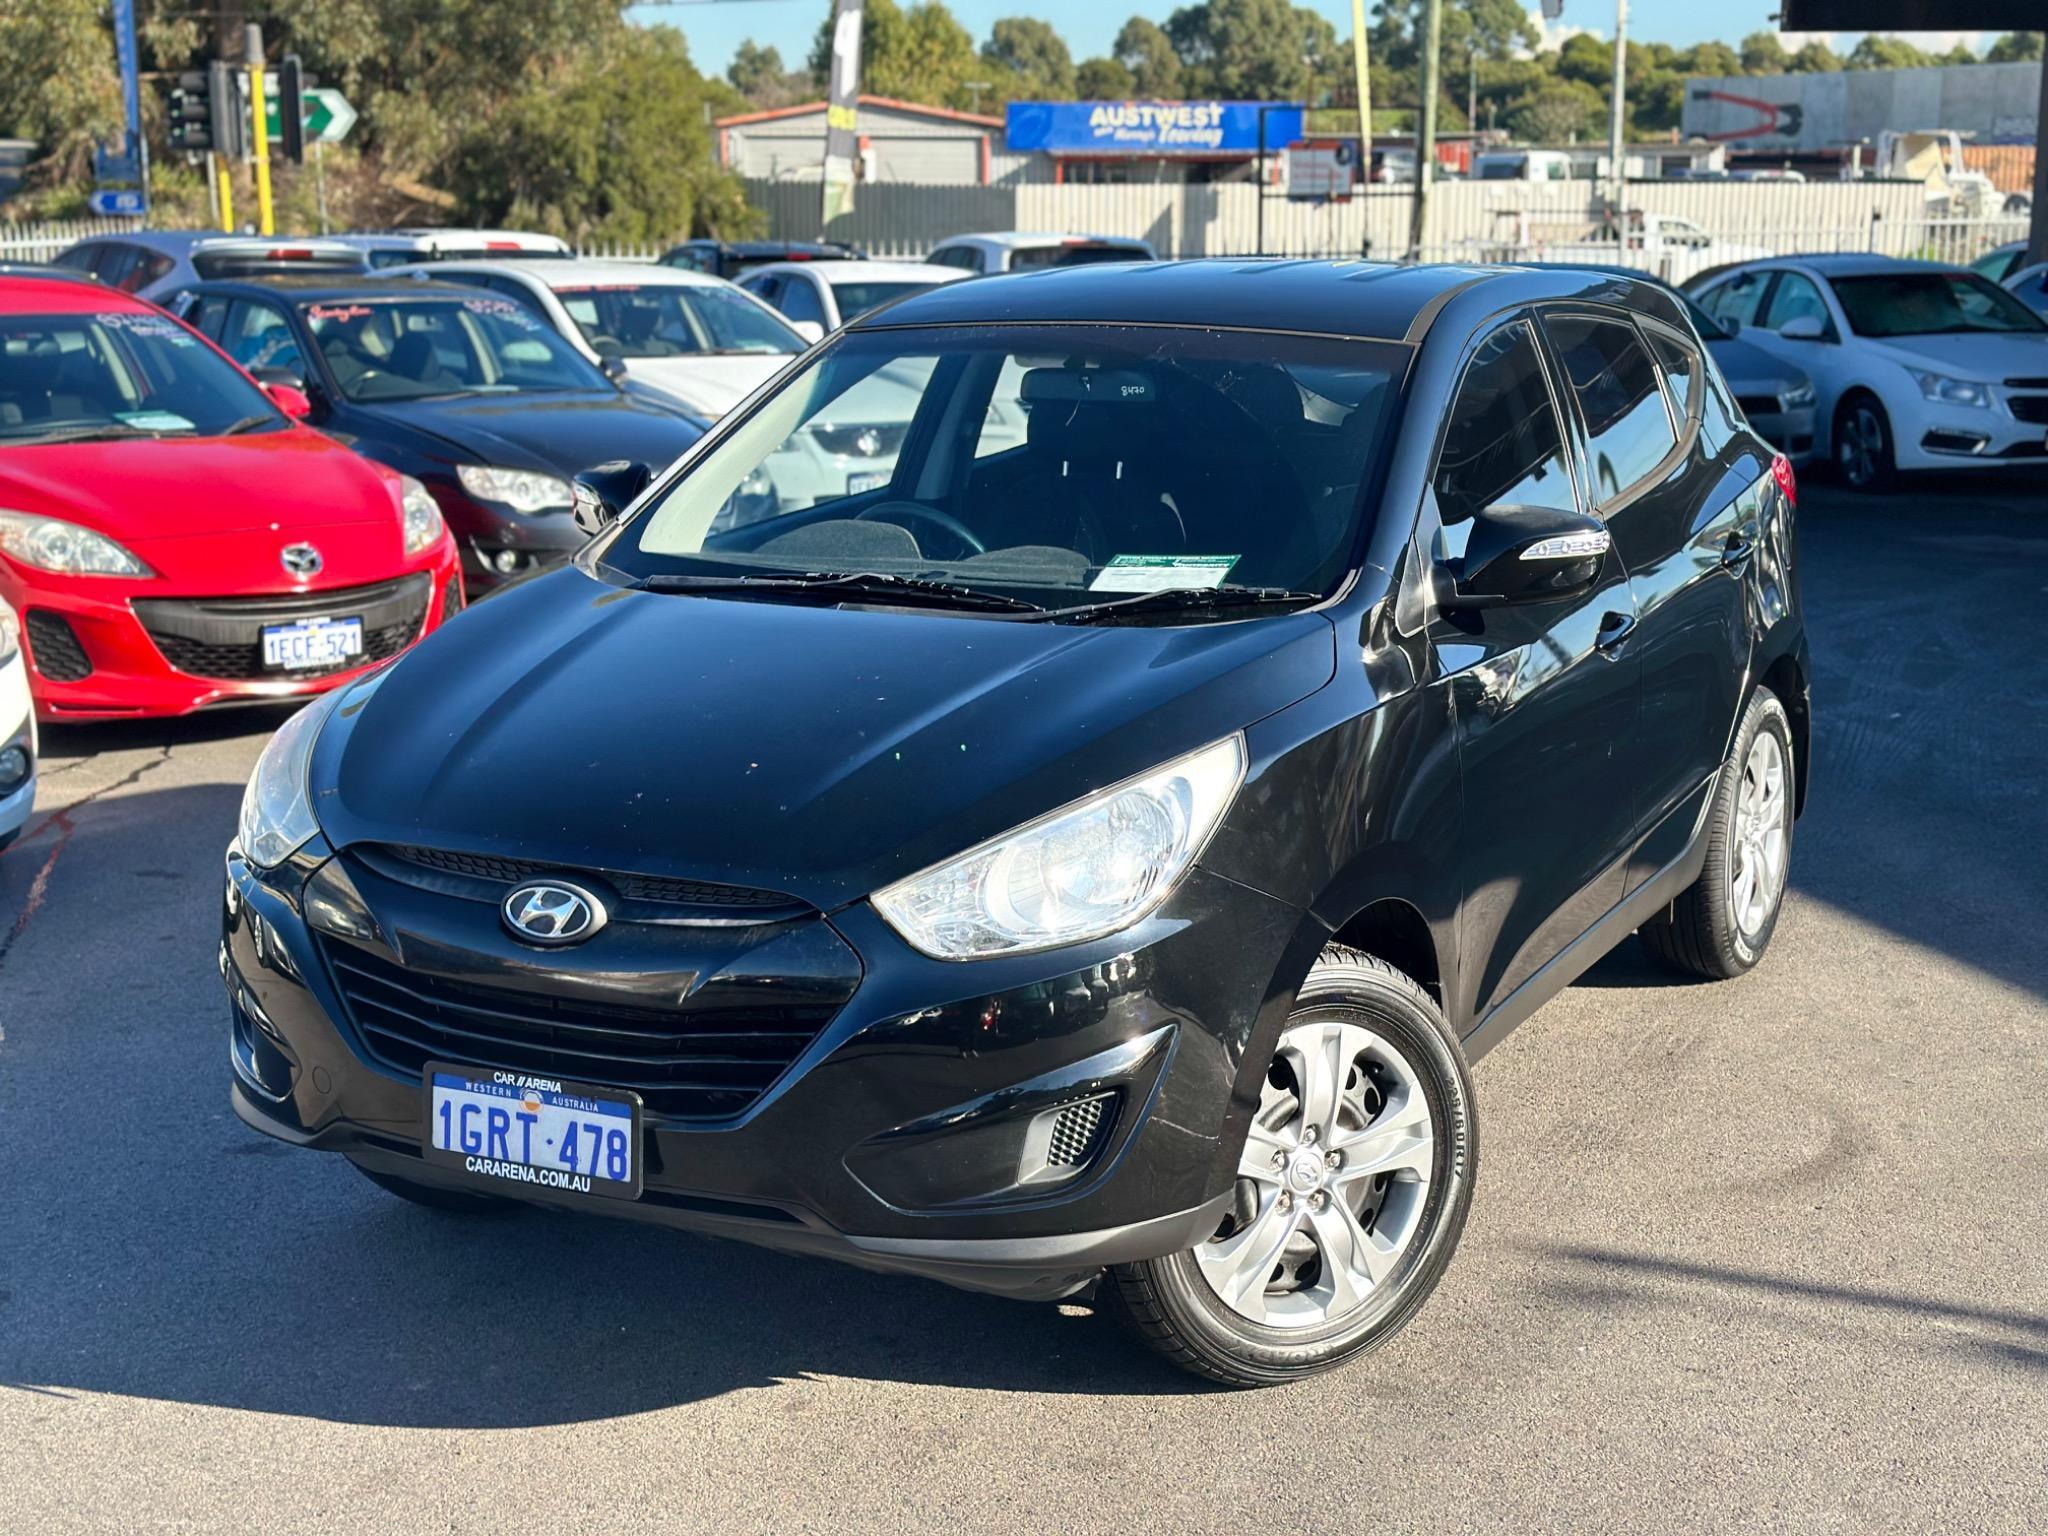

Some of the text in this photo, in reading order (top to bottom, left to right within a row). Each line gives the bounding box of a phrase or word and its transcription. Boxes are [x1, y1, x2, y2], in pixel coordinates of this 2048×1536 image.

[1089, 102, 1224, 128] AUSTWEST
[465, 1081, 599, 1112] WESTERN AUSTRALIA
[465, 1156, 591, 1193] CARARENA.COM.AU
